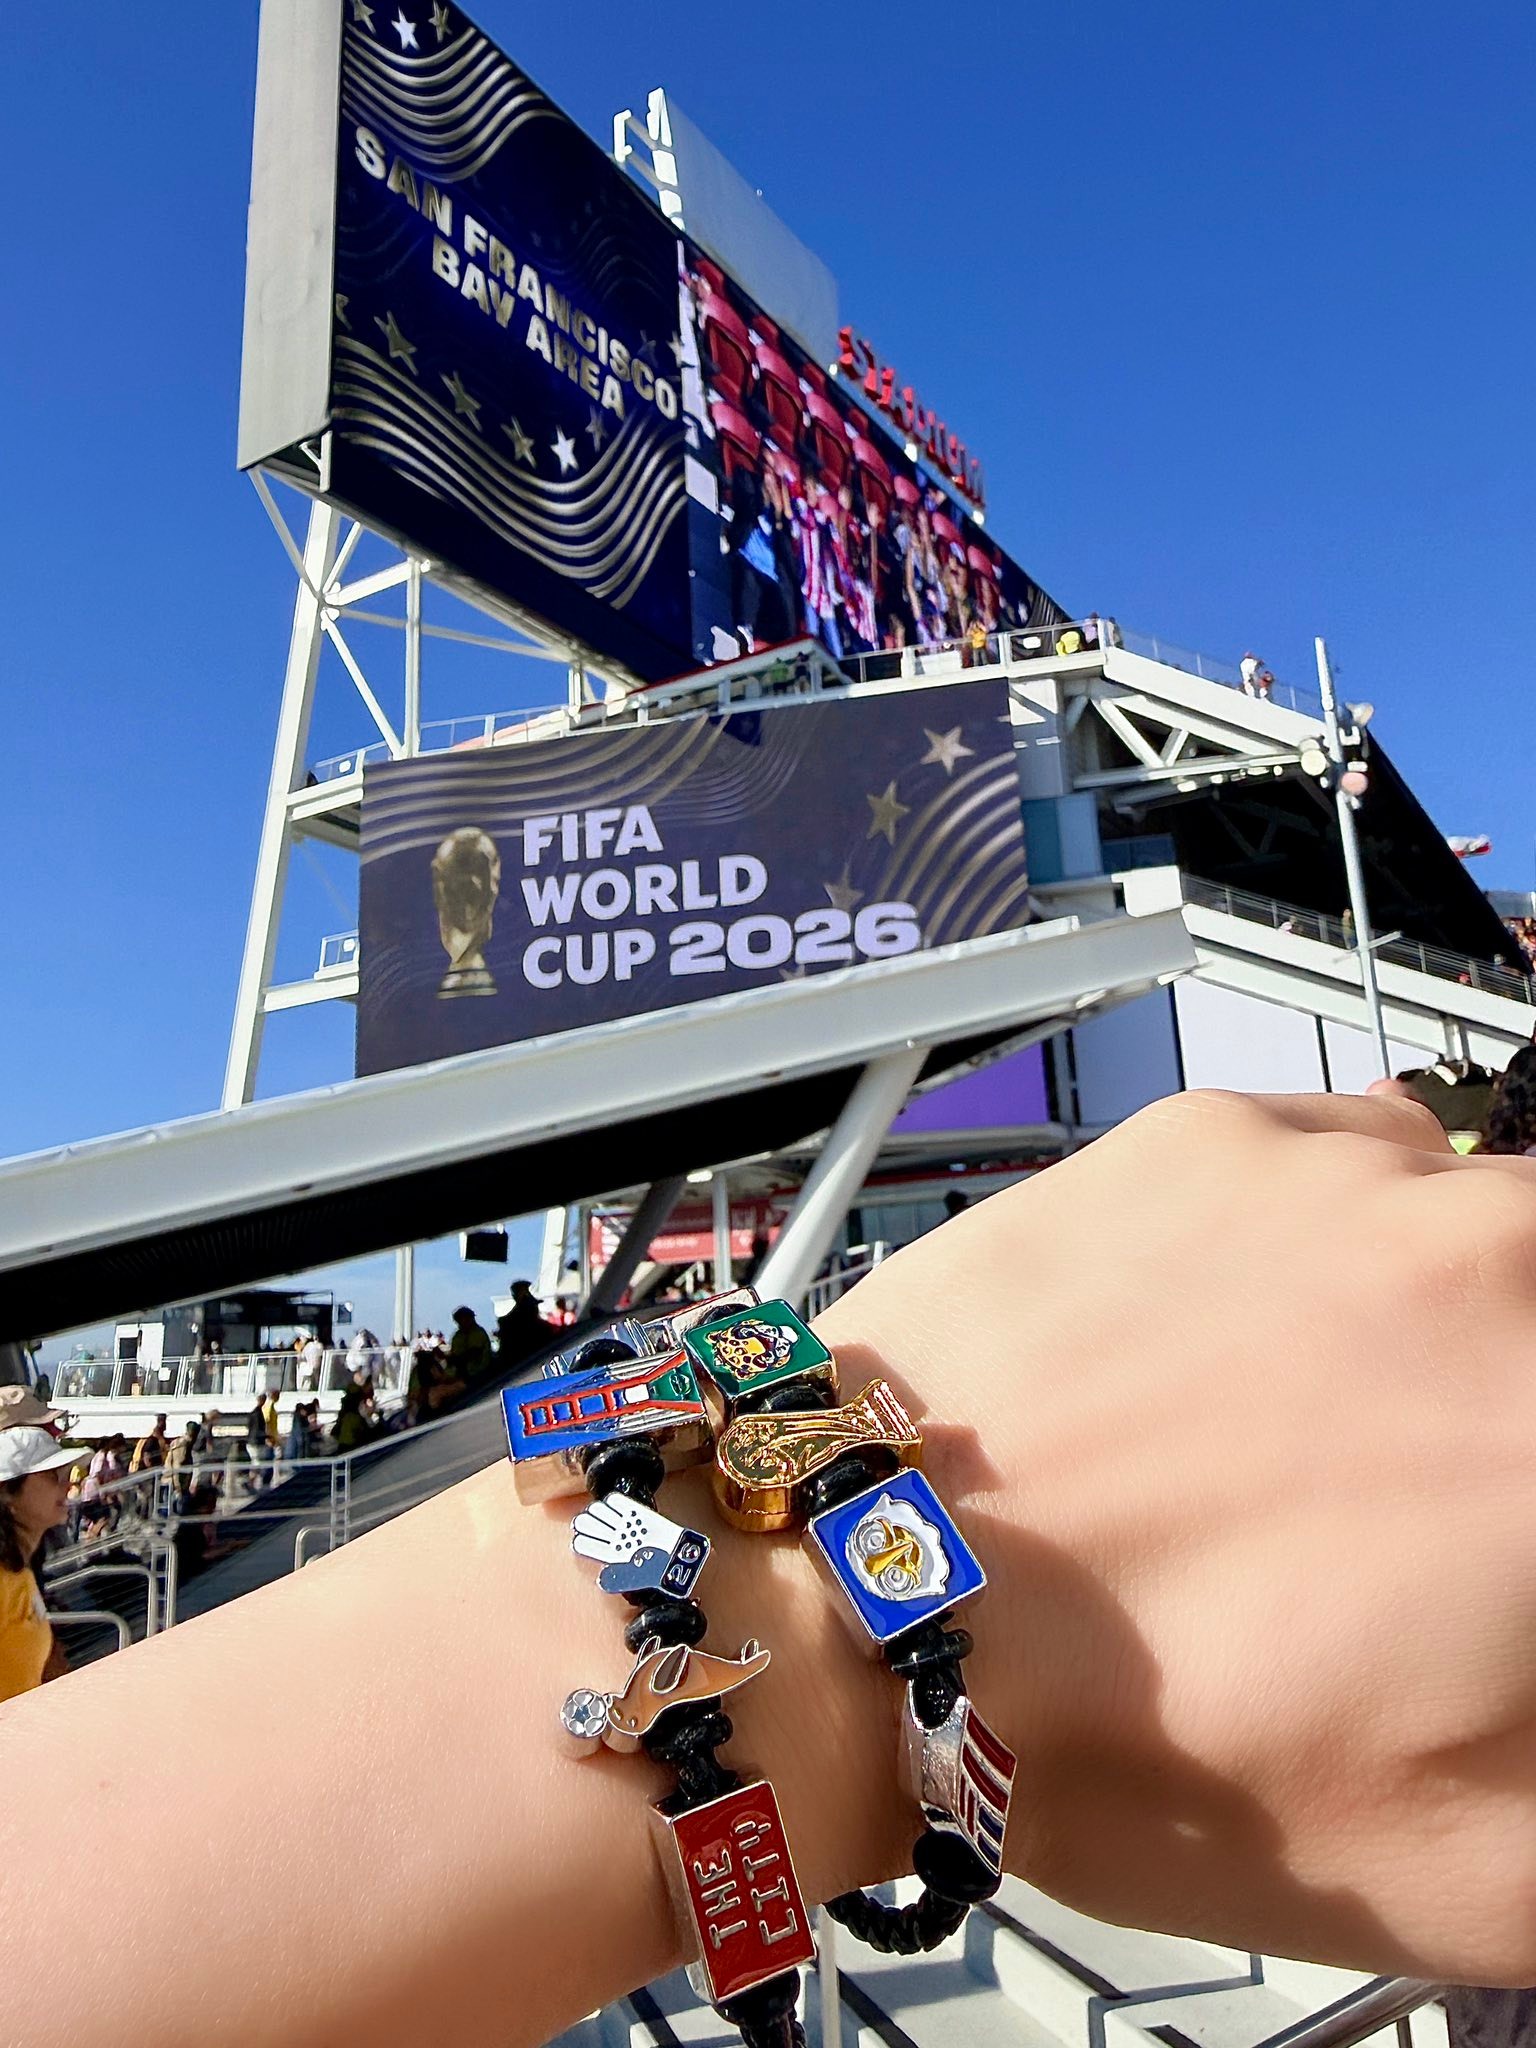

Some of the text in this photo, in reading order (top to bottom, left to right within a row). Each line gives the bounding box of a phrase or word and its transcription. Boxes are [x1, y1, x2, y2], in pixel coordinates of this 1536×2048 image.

[355, 125, 453, 238] SAN
[464, 214, 678, 421] FRANCISCO
[432, 233, 625, 420] BAY AREA
[522, 804, 665, 867] FIFA
[521, 853, 768, 927] WORLD
[522, 900, 922, 989] CUP 2026
[665, 1541, 702, 1588] 26
[693, 1847, 748, 1950] THE
[734, 1820, 799, 1946] CITY
